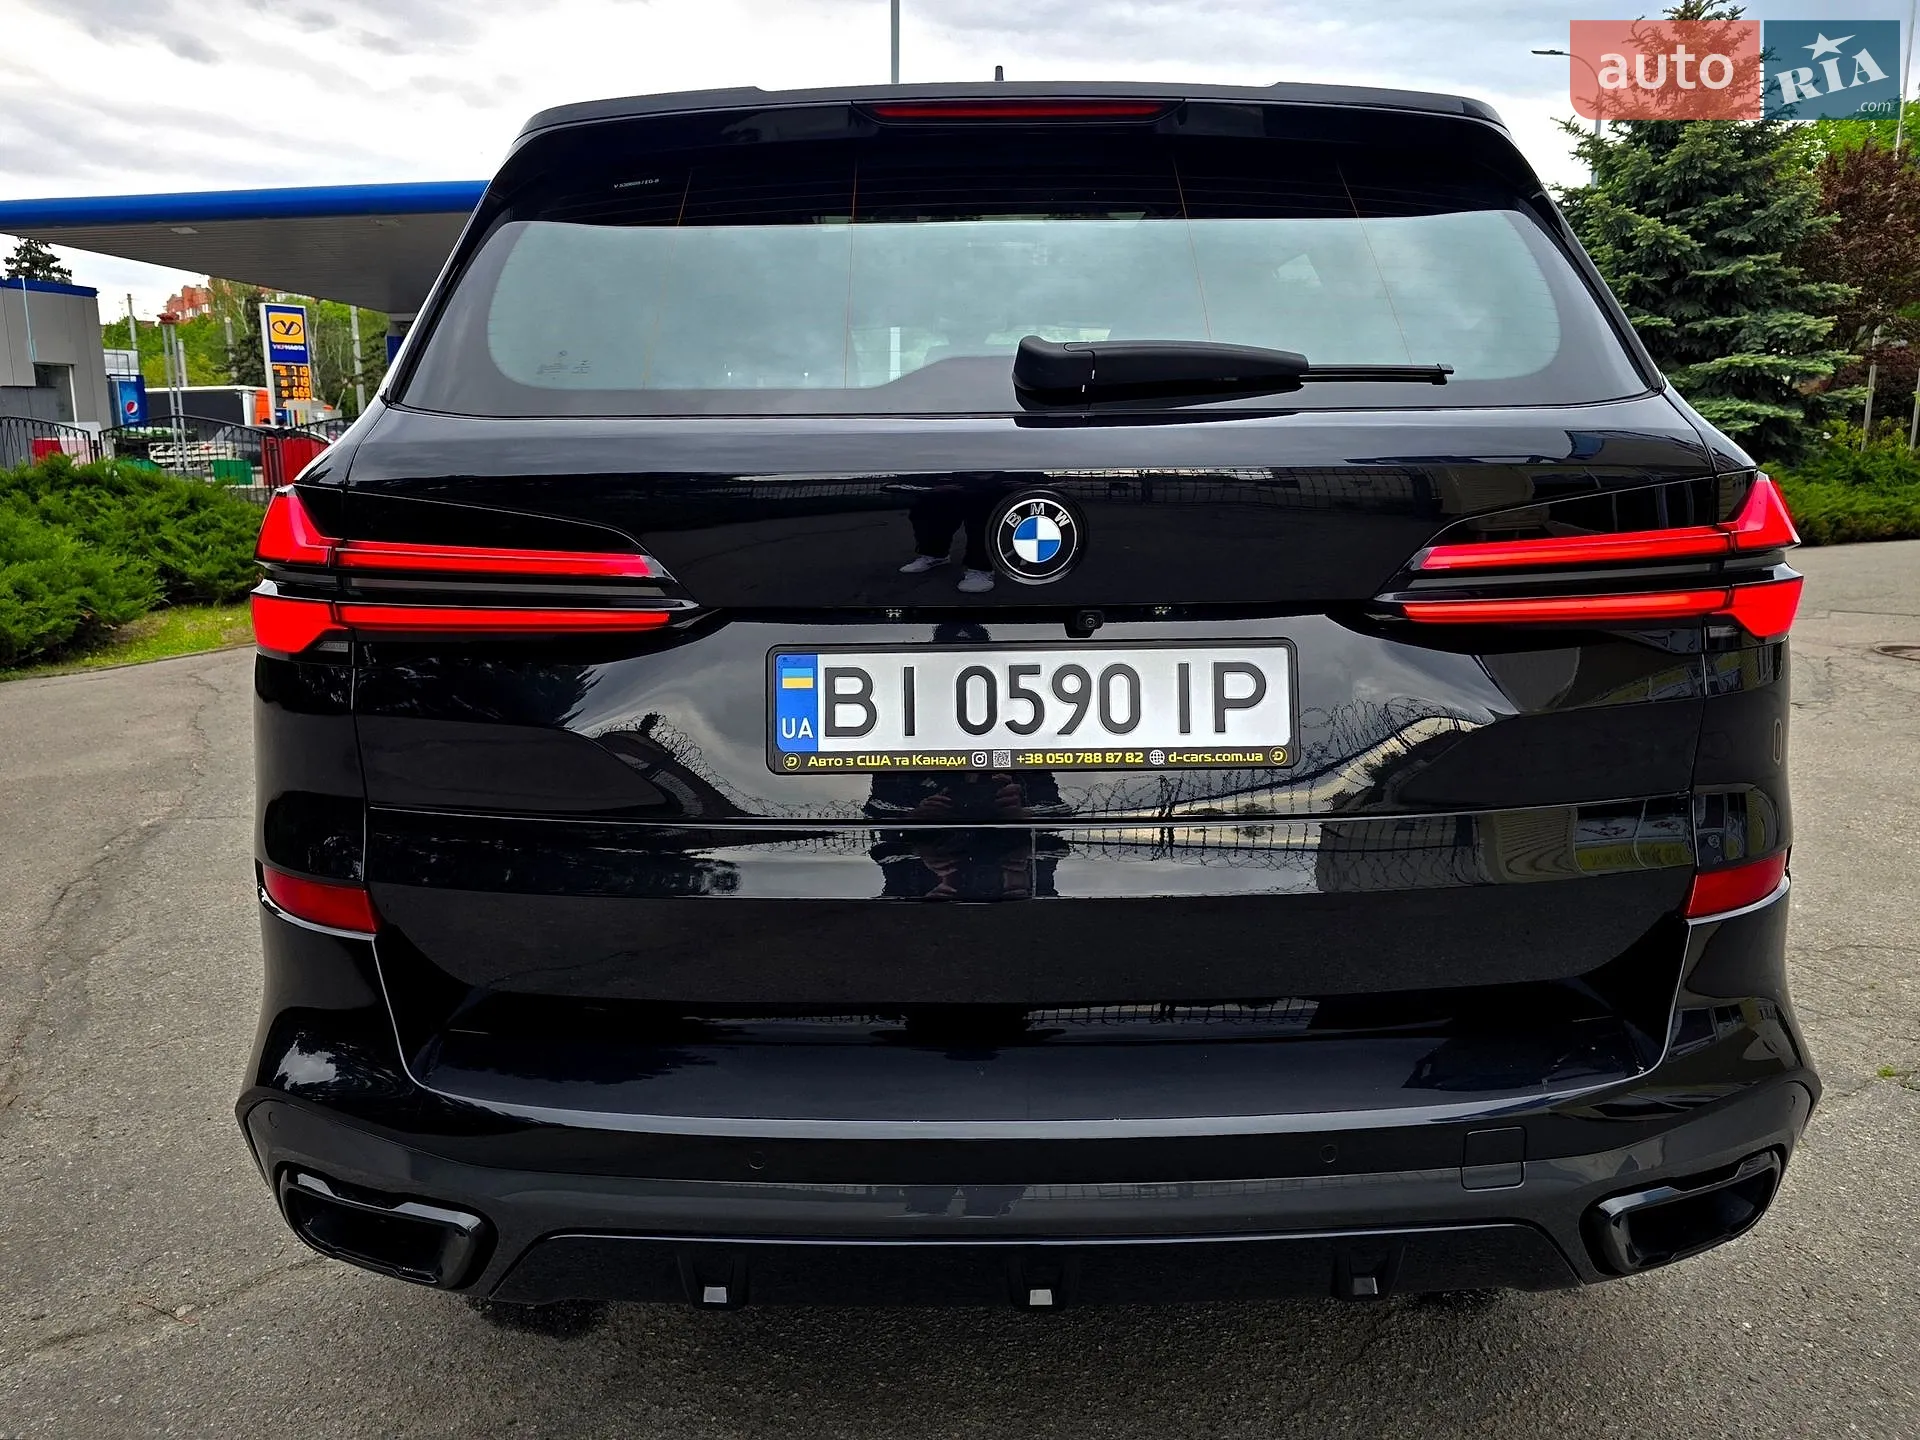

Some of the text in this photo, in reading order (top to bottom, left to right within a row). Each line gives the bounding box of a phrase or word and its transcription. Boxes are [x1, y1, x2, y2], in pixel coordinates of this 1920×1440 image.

[1005, 502, 1071, 528] BMW
[823, 661, 1267, 738] BI 0590 IP
[781, 717, 814, 739] UA
[807, 754, 967, 768] Авто з США та Канади
[1016, 751, 1144, 764] +38 050 788 87 82
[1168, 751, 1264, 763] d-cars.com.ua
